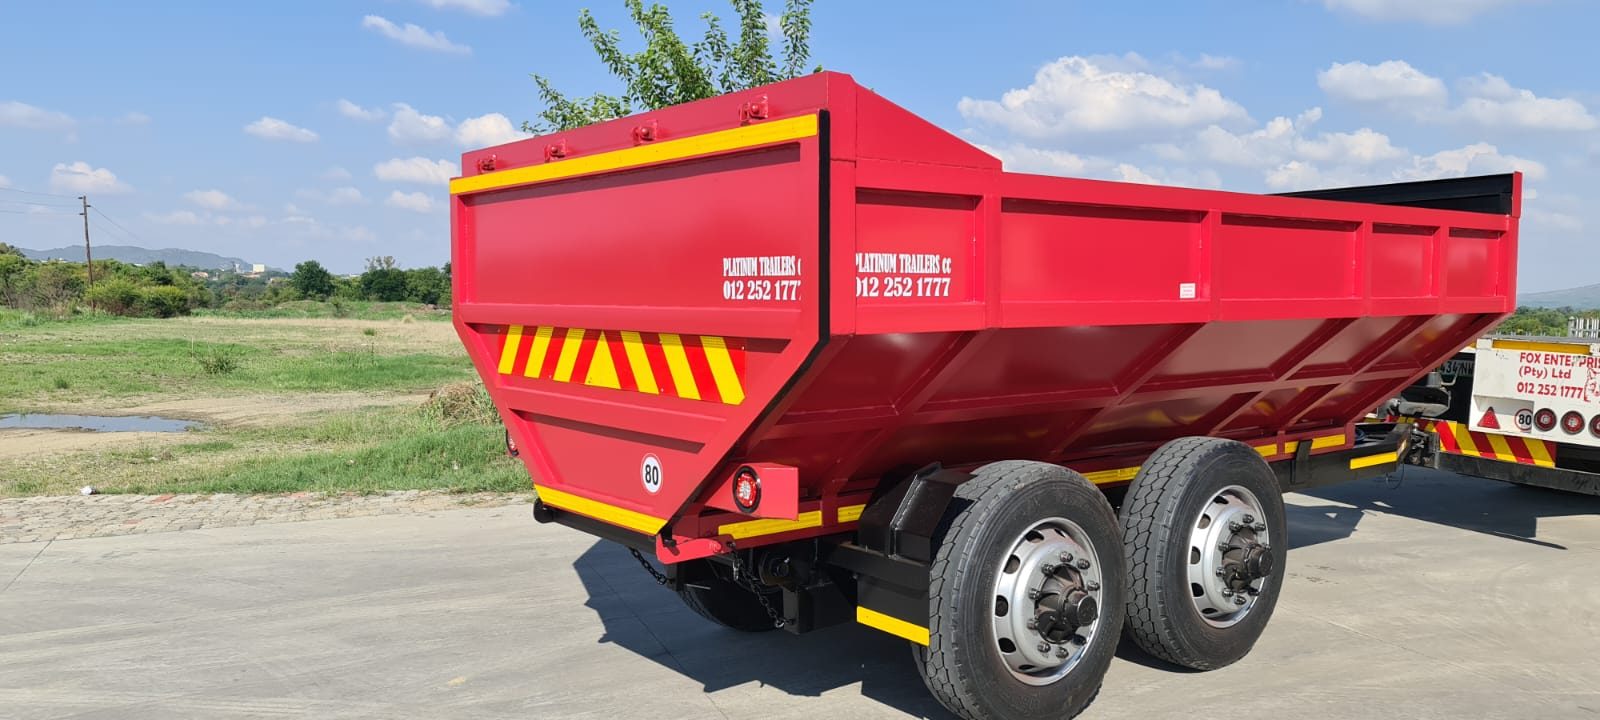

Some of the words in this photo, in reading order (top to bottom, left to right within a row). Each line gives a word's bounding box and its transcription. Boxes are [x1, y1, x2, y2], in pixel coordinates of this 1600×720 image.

[723, 257, 758, 276] PLATINUM
[759, 255, 796, 276] TRAILERS
[899, 253, 940, 273] TRAILERS
[942, 257, 951, 274] cc
[723, 280, 744, 299] 012
[747, 280, 771, 300] 252
[883, 276, 913, 297] 252
[916, 277, 951, 297] 1777
[1520, 352, 1541, 364] FOX
[1519, 365, 1548, 379] (Pty)
[1551, 368, 1572, 379] Ltd
[1517, 382, 1535, 394] 012
[1537, 383, 1557, 396] 252
[1560, 385, 1584, 398] 1777
[1518, 414, 1532, 425] 80
[645, 464, 659, 486] 80
